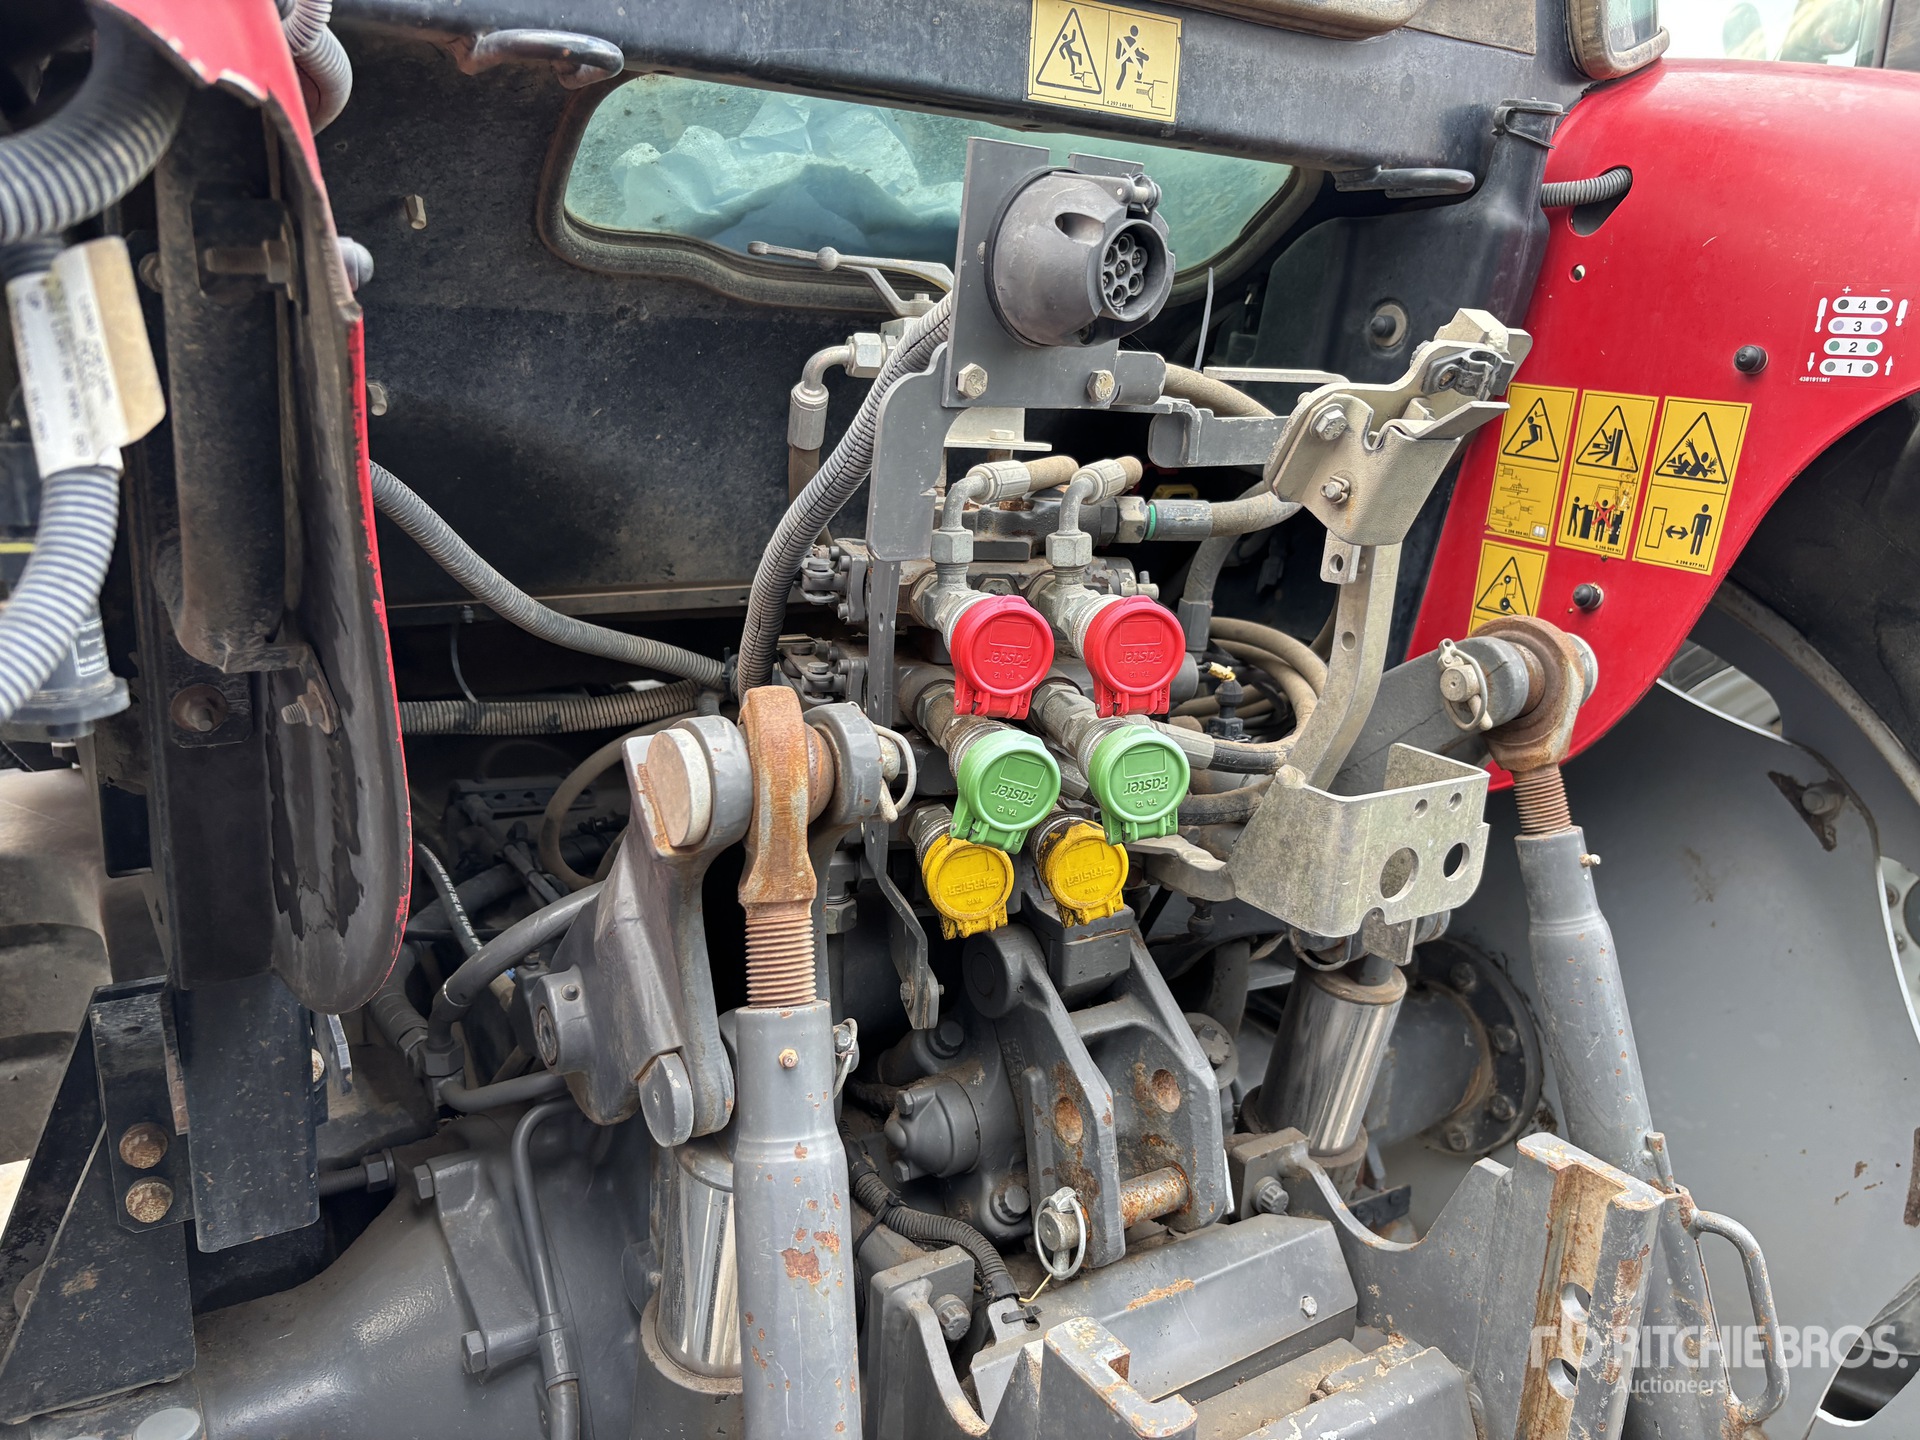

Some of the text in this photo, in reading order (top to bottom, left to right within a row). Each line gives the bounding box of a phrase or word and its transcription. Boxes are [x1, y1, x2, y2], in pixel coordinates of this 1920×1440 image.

[1858, 300, 1867, 311] 4
[1853, 321, 1862, 332] 3
[1848, 342, 1858, 353] 2
[1846, 363, 1853, 374] 1
[984, 651, 1033, 669] Faster
[1118, 650, 1163, 665] Faster
[1123, 776, 1169, 795] Faster
[990, 784, 1037, 808] Faster
[1136, 798, 1158, 808] TA 12
[996, 805, 1017, 816] TA 12
